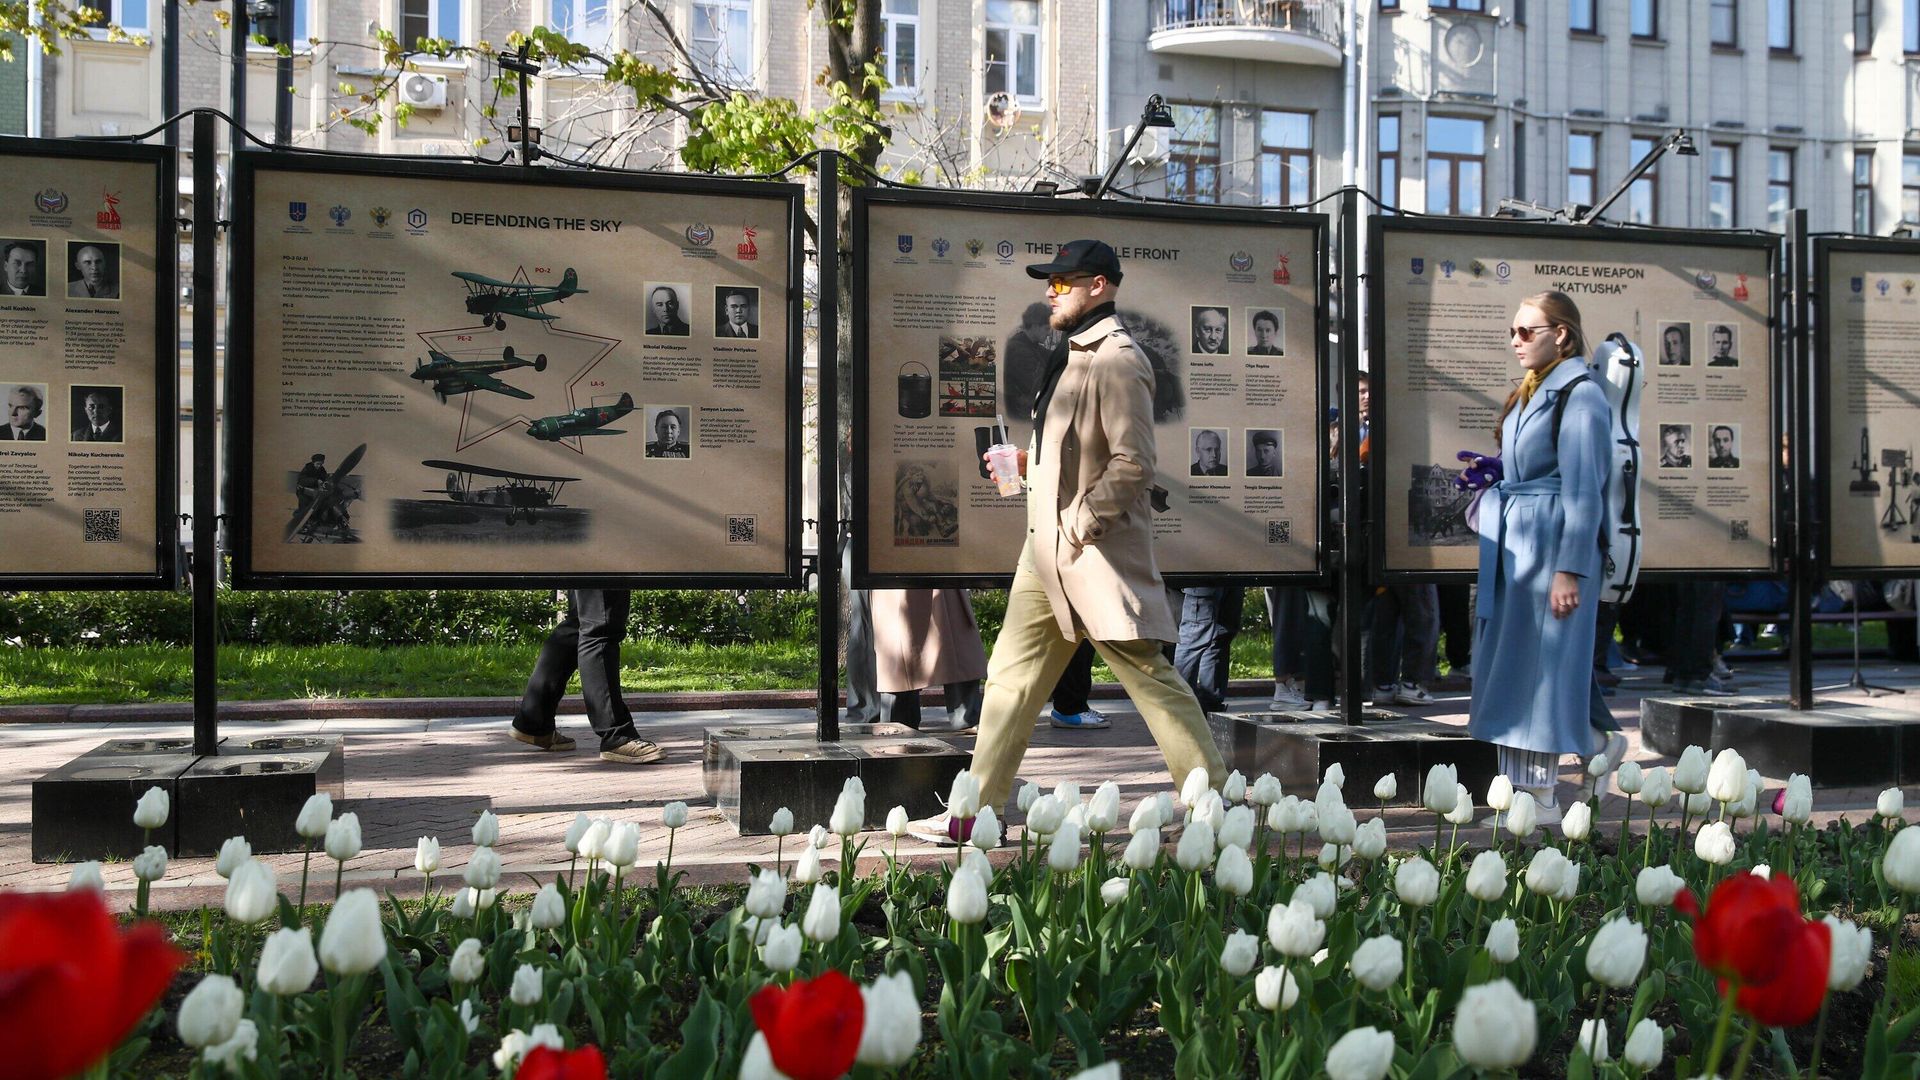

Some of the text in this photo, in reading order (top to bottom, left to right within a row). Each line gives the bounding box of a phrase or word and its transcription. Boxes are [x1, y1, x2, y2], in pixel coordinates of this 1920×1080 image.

[451, 212, 622, 232] DEFENDING THE SKY
[1025, 242, 1052, 254] THE
[1134, 247, 1180, 260] FRONT
[1534, 264, 1644, 278] MIRACLE WEAPON
